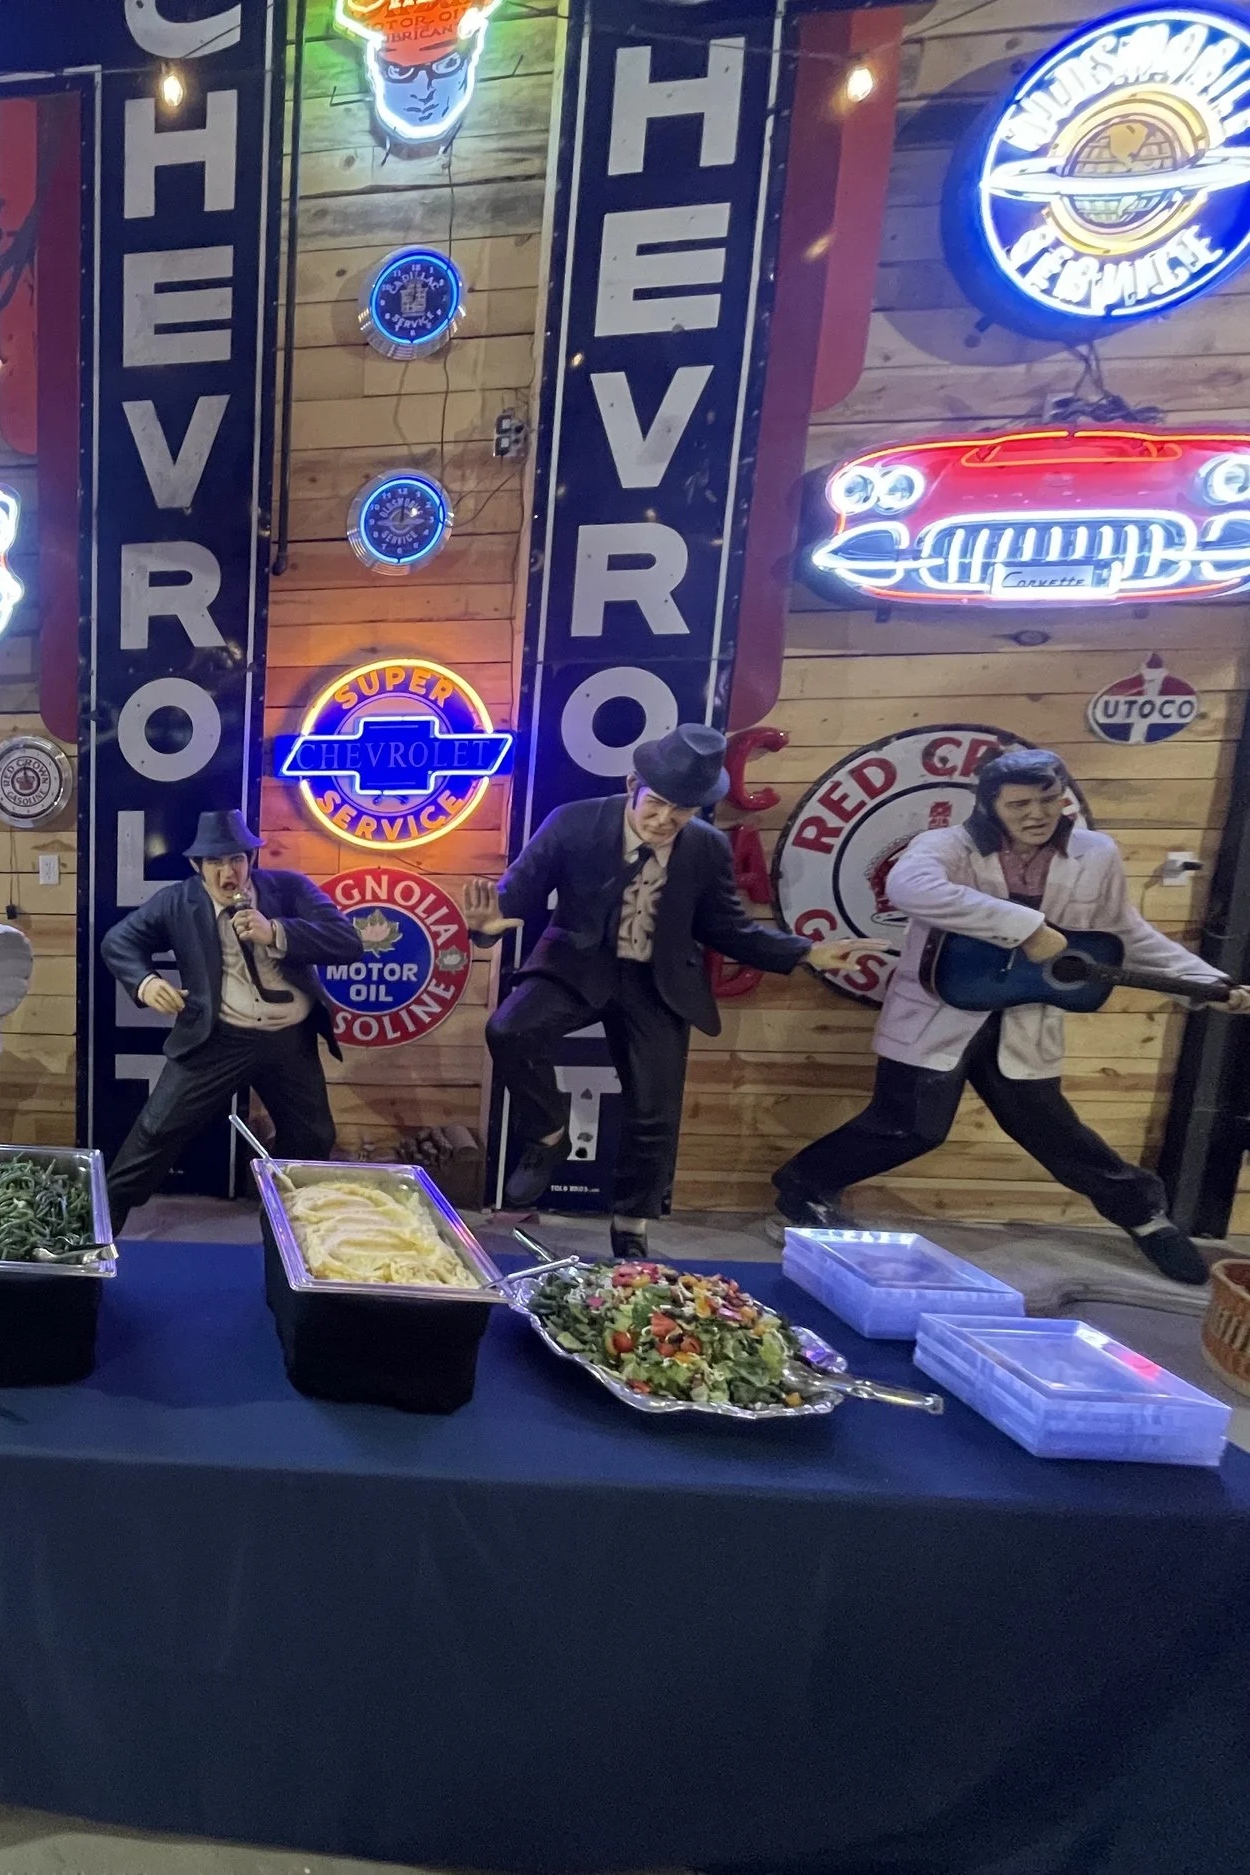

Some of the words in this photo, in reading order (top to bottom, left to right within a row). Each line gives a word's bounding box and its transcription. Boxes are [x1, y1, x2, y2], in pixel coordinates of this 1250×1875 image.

[114, 0, 241, 1096] HEVROL
[334, 667, 455, 709] SUPER
[1103, 699, 1195, 719] UTOCO
[296, 739, 490, 770] CHEVROLET
[3, 766, 15, 788] RED
[16, 759, 49, 784] CROWN
[7, 788, 47, 805] GASOLINE
[791, 757, 898, 854] RED
[316, 789, 467, 841] SERVICE
[335, 875, 459, 946] GNOLIA
[326, 962, 419, 981] MOTOR
[333, 979, 455, 1041] SOLINE
[350, 984, 393, 1002] OIL
